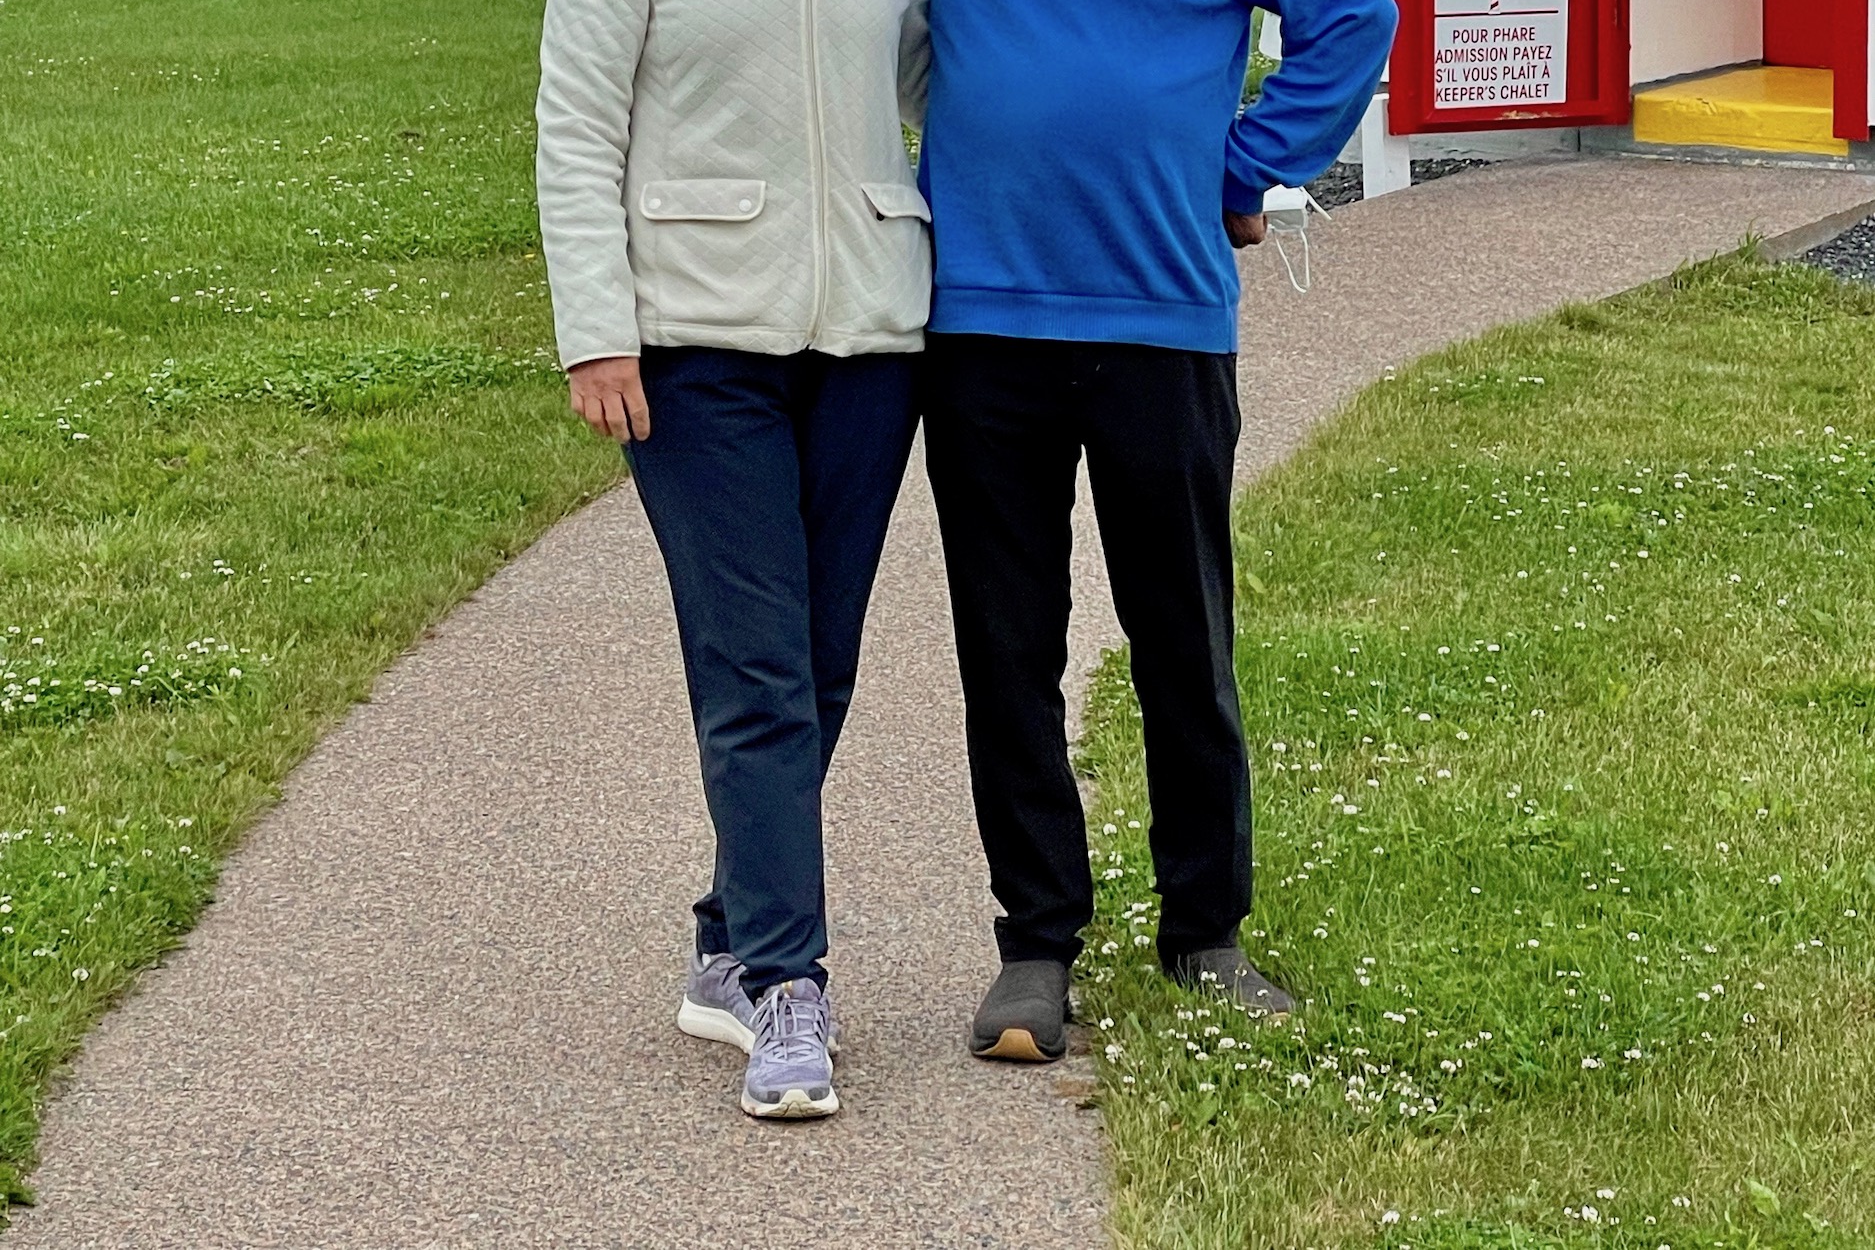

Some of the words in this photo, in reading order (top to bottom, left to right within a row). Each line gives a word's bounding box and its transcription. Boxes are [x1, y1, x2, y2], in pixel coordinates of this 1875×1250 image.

[1452, 28, 1489, 44] POUR
[1493, 26, 1536, 43] PHARE
[1435, 47, 1508, 64] ADMISSION
[1513, 45, 1552, 61] PAYEZ
[1435, 67, 1458, 84] S'IL
[1462, 66, 1498, 83] VOUS
[1502, 61, 1539, 80] PLAÎT
[1541, 60, 1551, 79] À
[1435, 85, 1496, 104] KEEPER'S
[1500, 83, 1549, 101] CHALET
